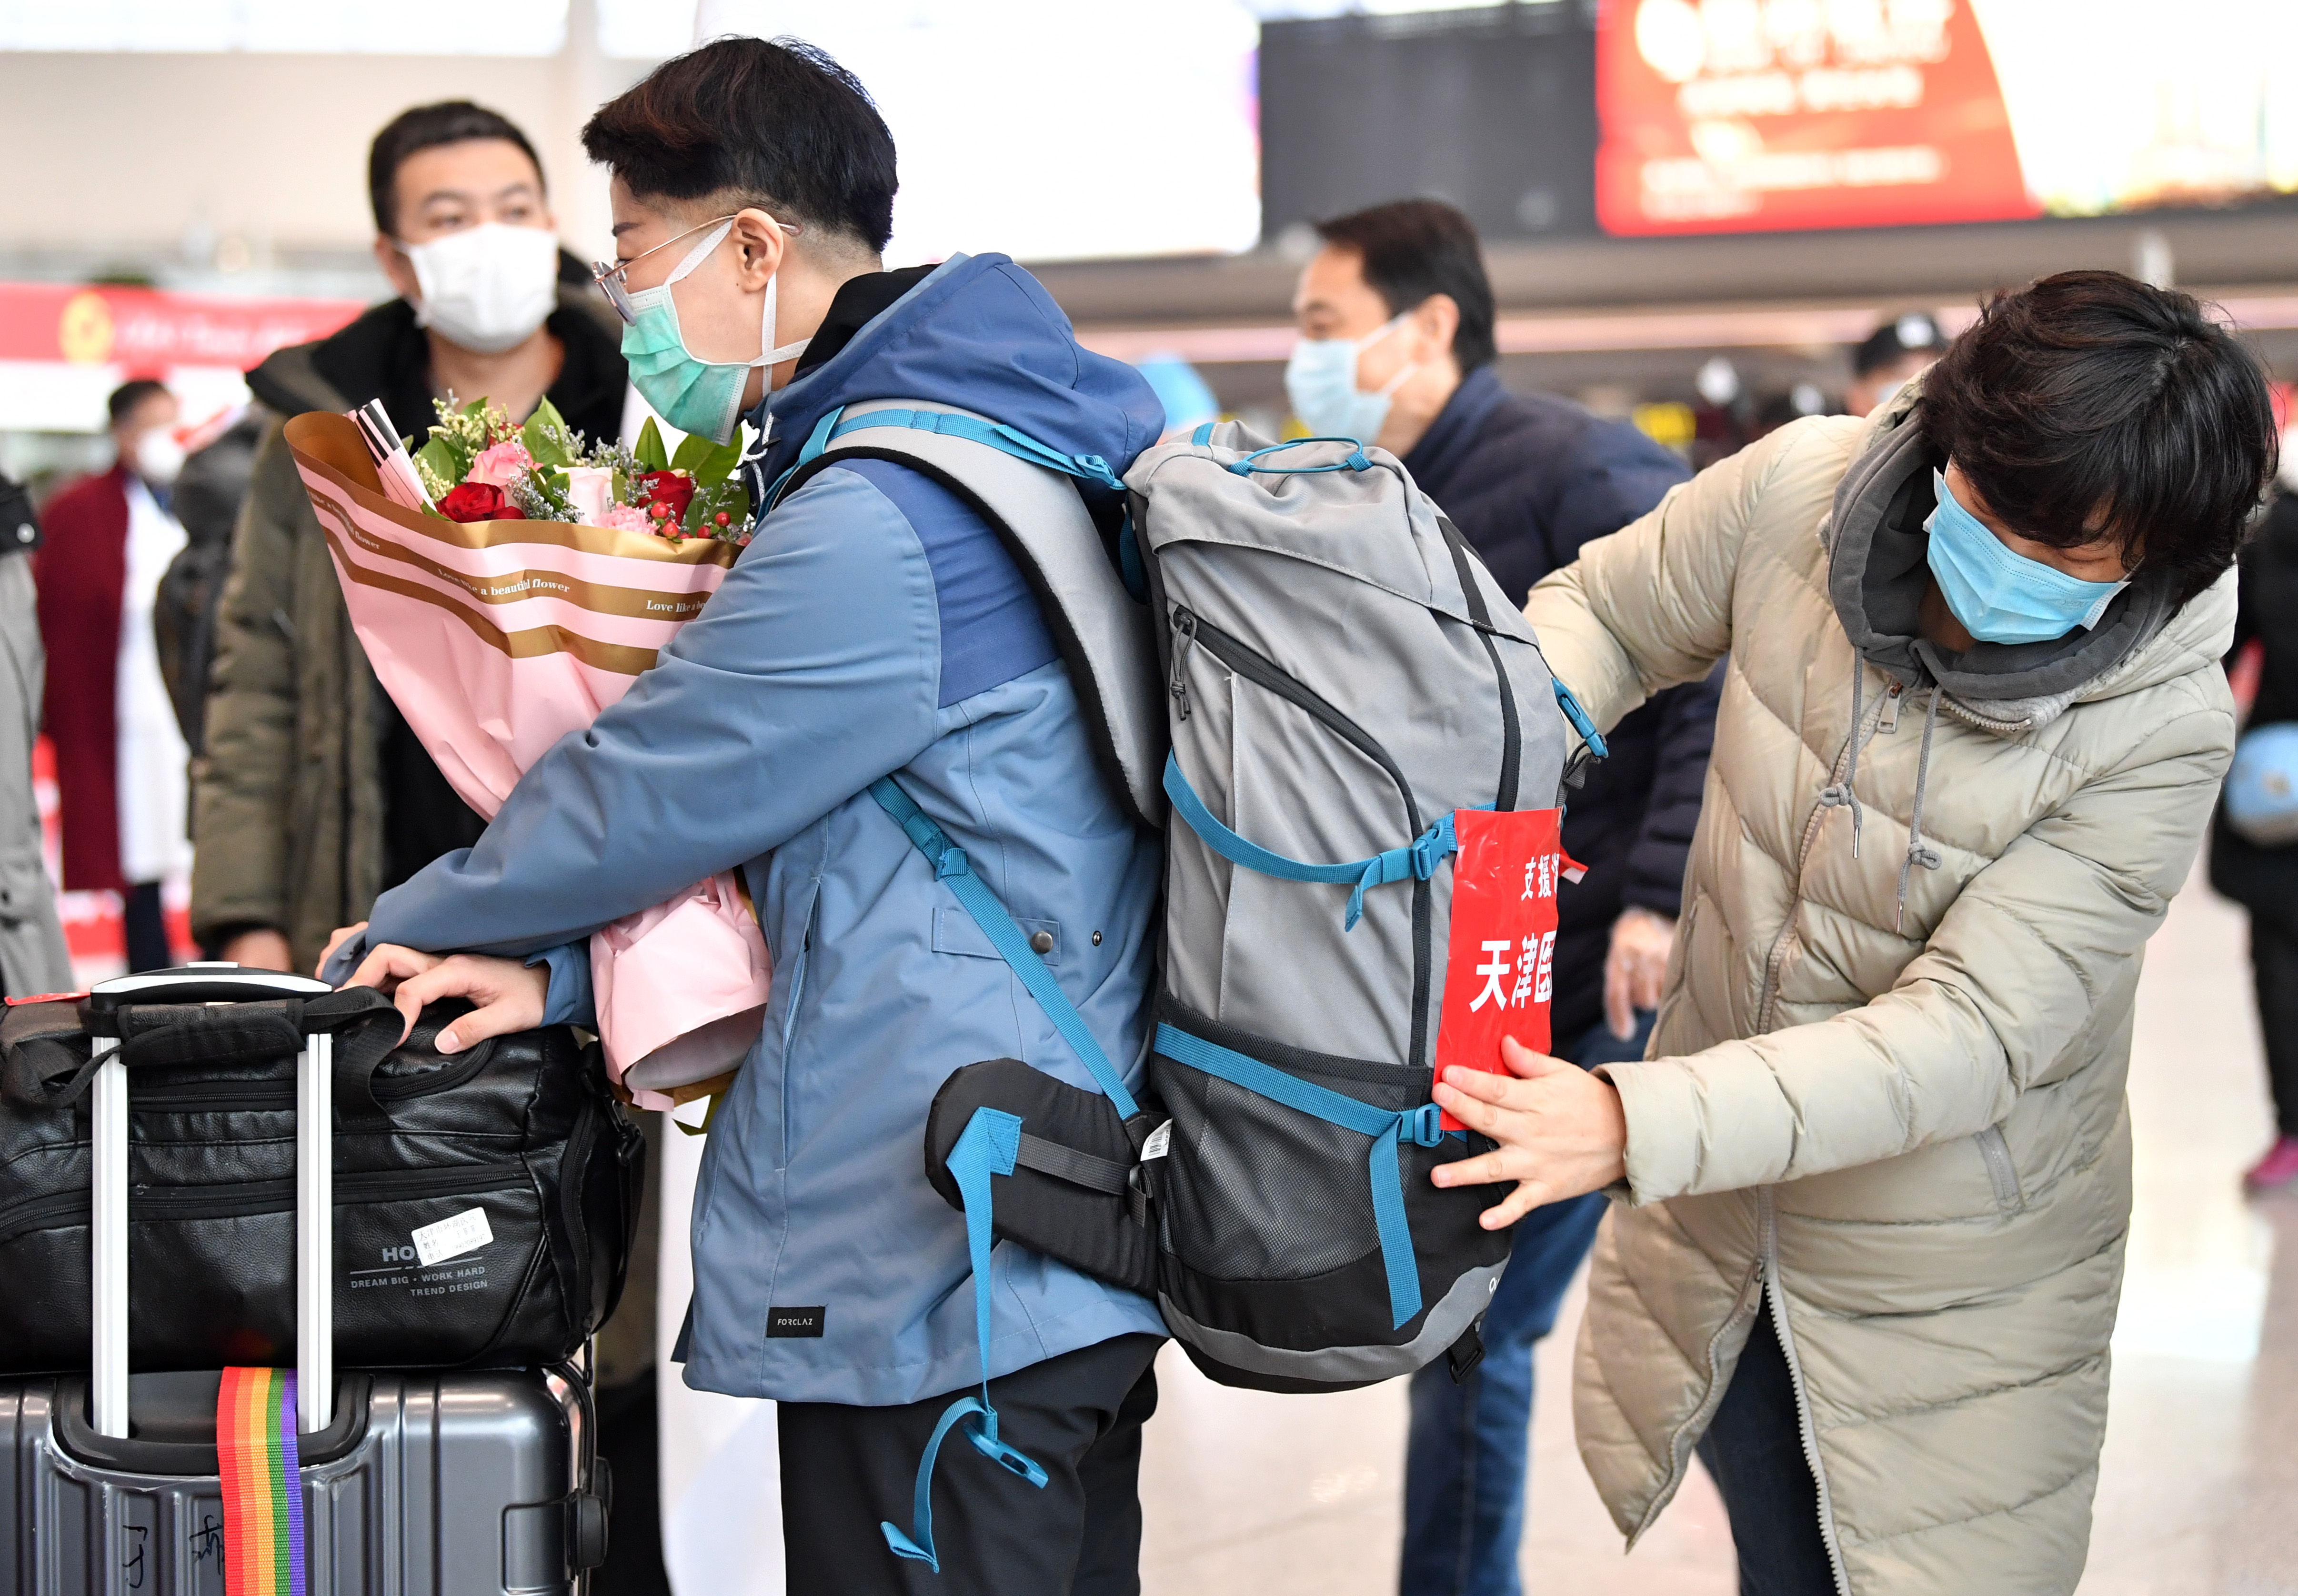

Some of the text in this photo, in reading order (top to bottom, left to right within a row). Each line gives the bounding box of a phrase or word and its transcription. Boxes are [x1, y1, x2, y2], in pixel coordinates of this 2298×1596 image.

[532, 579, 570, 593] flower
[646, 600, 673, 612] Love
[675, 603, 691, 612] like
[351, 1267, 485, 1288] DREAM BIG WORK HARD
[410, 1280, 488, 1297] TREND DESIGN
[777, 1318, 813, 1326] FORCLAZ
